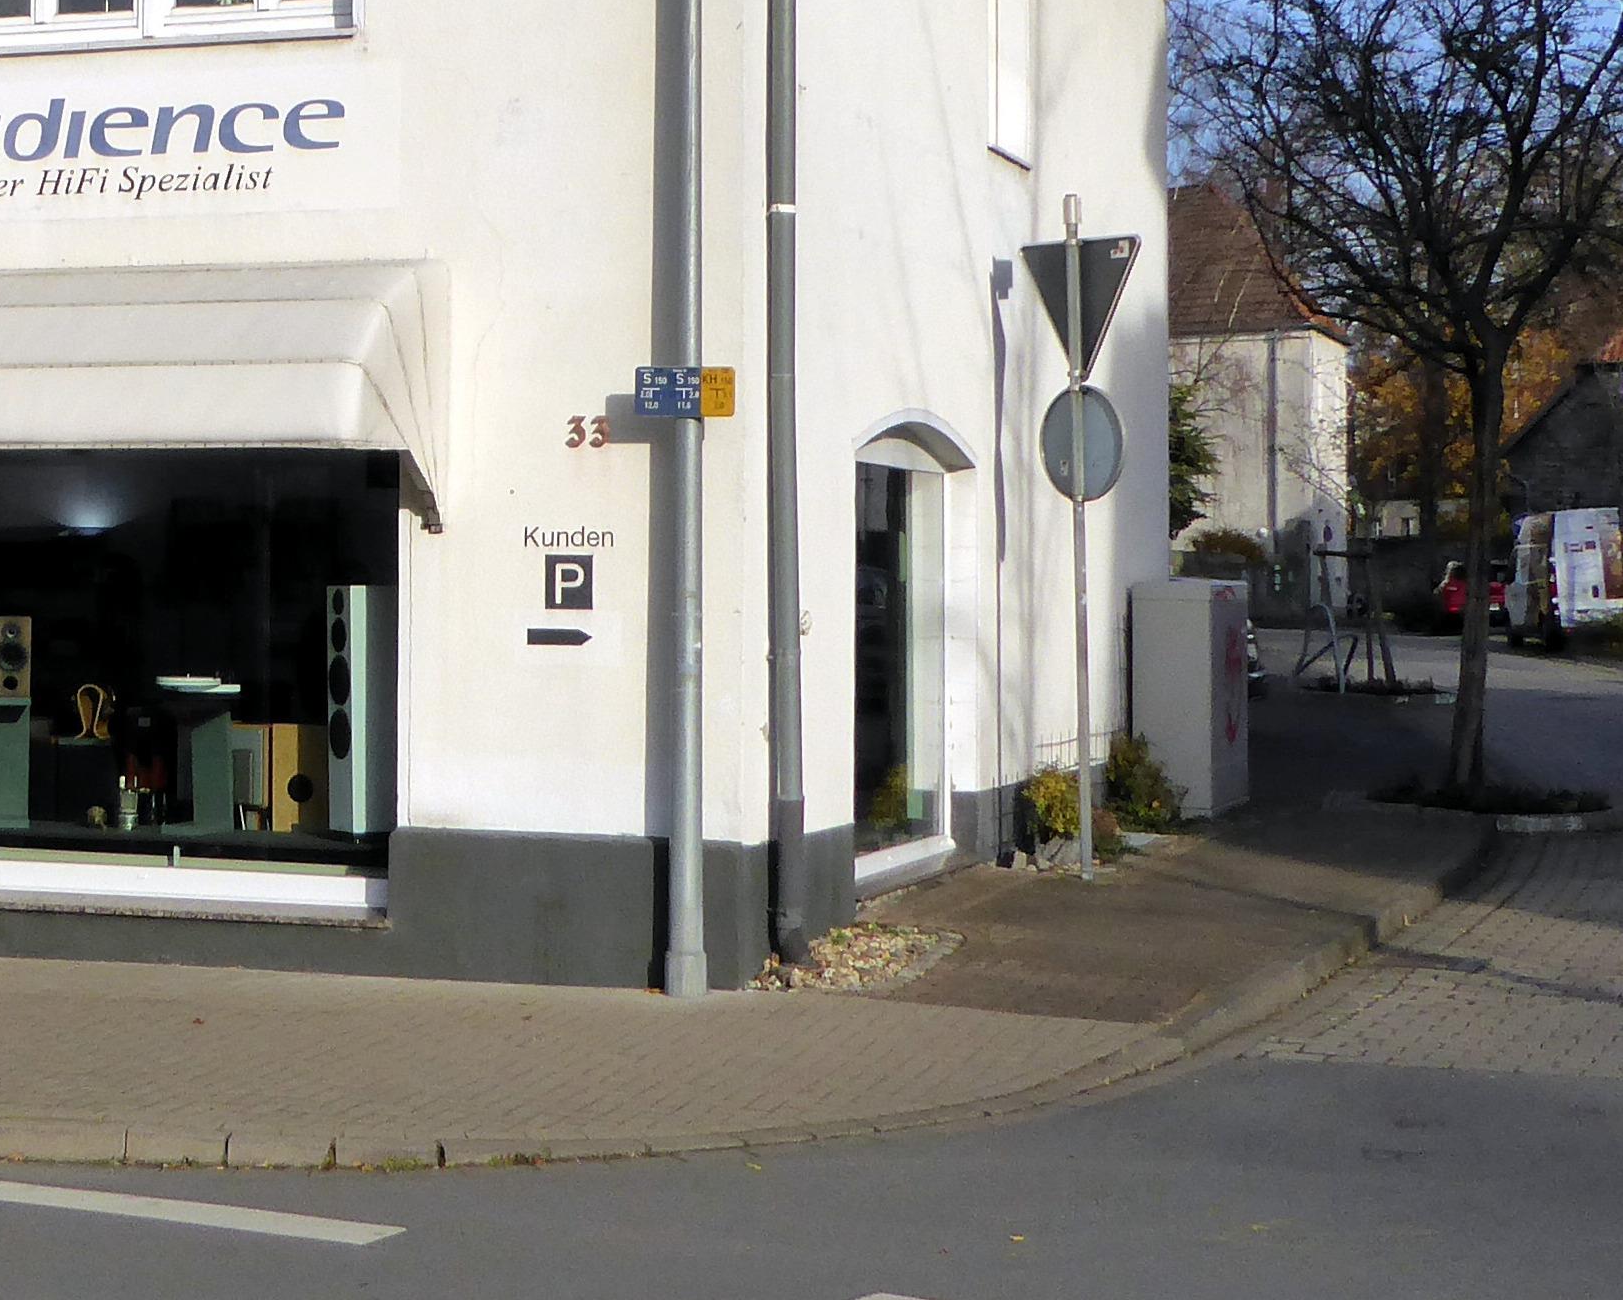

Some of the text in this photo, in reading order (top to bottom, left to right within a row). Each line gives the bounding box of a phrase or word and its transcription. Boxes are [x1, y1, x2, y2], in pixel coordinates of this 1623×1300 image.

[35, 167, 109, 197] HiFi
[118, 163, 274, 200] Spezialist
[643, 373, 652, 384] S
[676, 373, 684, 384] S
[564, 415, 610, 449] 33
[524, 526, 614, 548] Kunden
[555, 562, 585, 605] P
